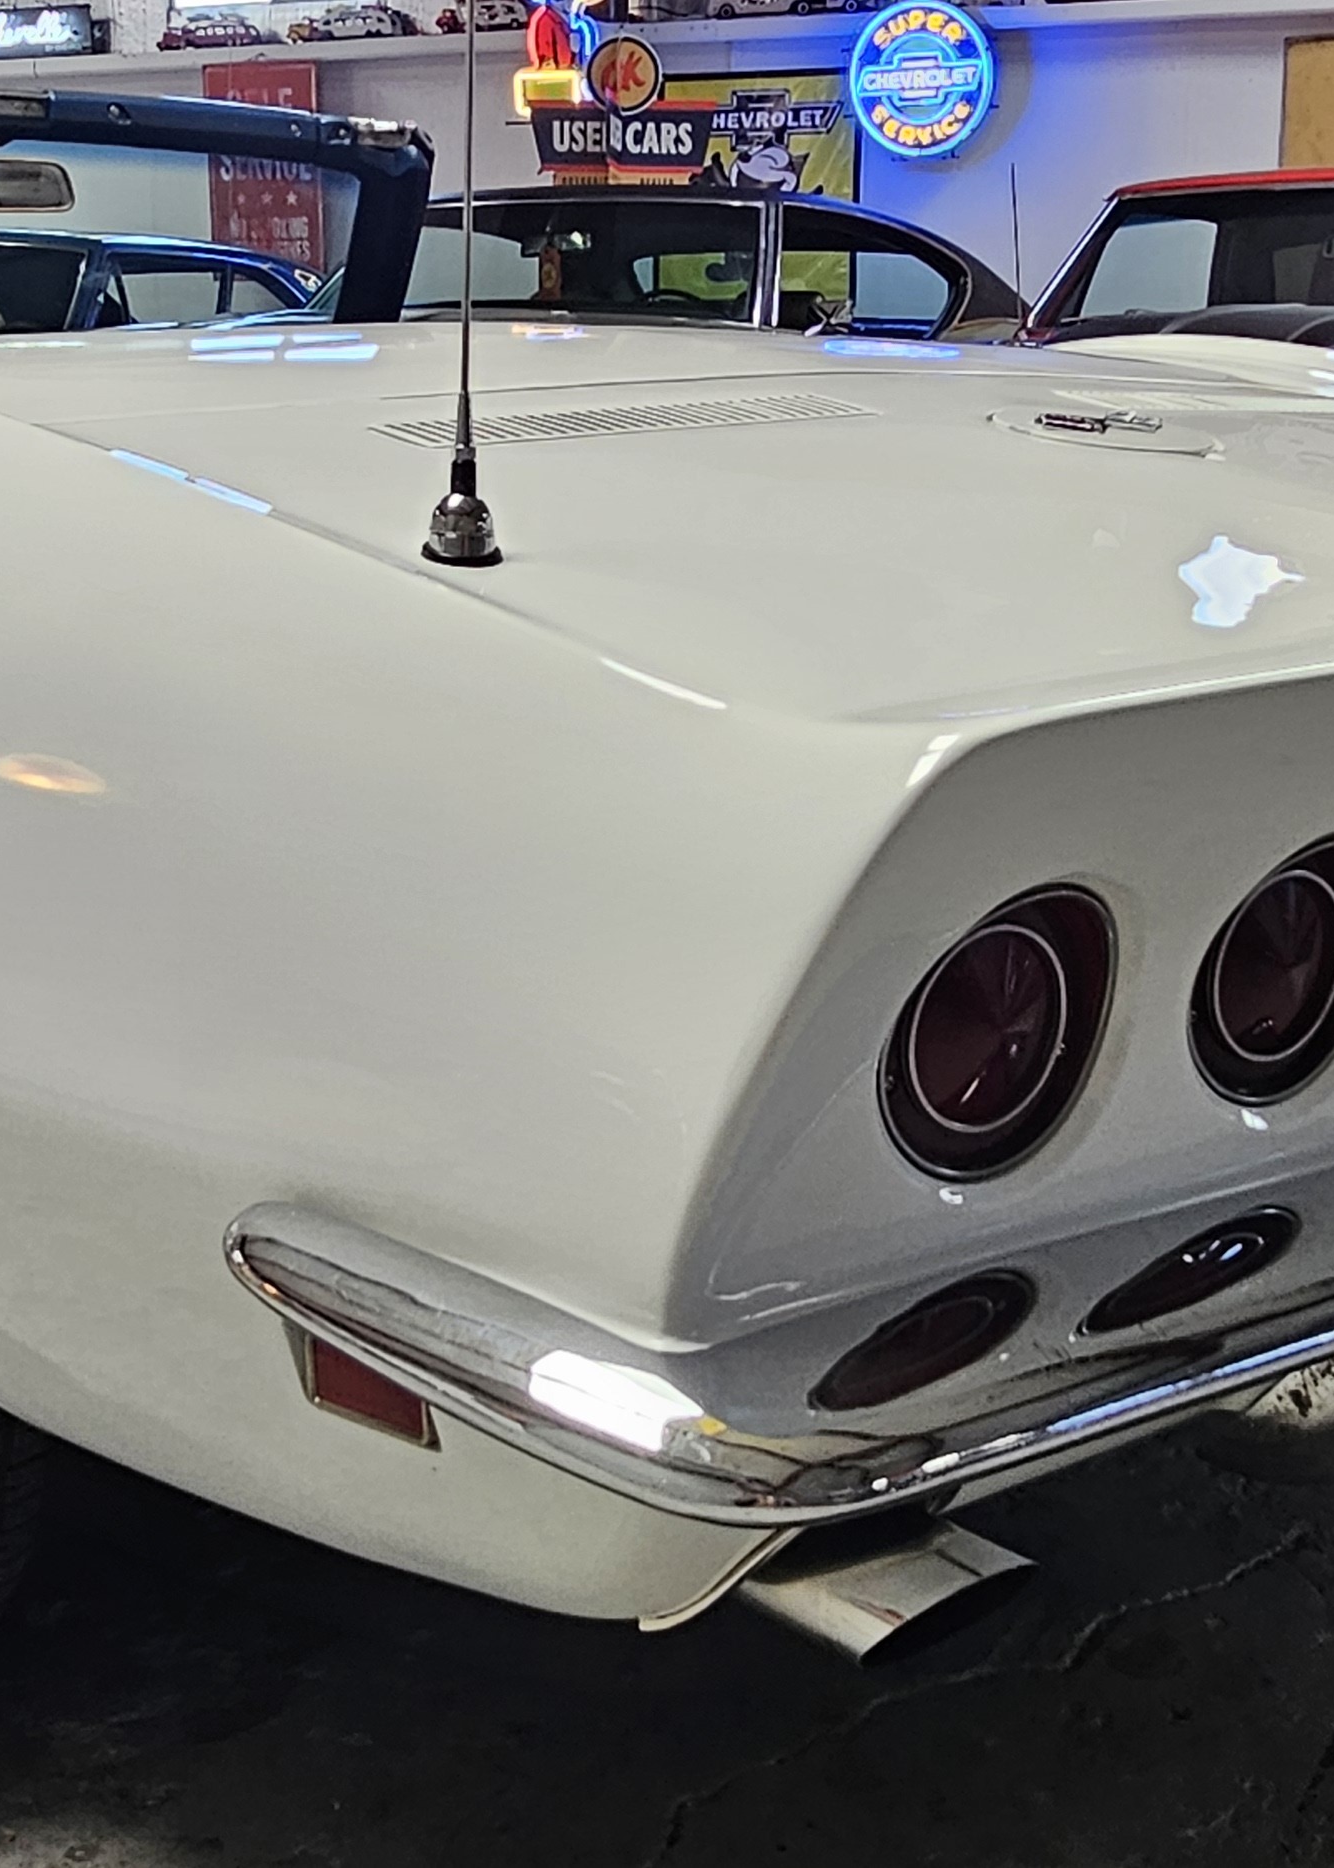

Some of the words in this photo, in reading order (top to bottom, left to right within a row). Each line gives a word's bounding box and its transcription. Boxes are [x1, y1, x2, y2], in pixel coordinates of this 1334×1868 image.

[873, 9, 966, 49] SUPER
[863, 66, 977, 91] CHEVROLET
[712, 110, 824, 129] HEVROLET
[871, 101, 972, 145] SERVICE
[625, 121, 693, 155] CARS
